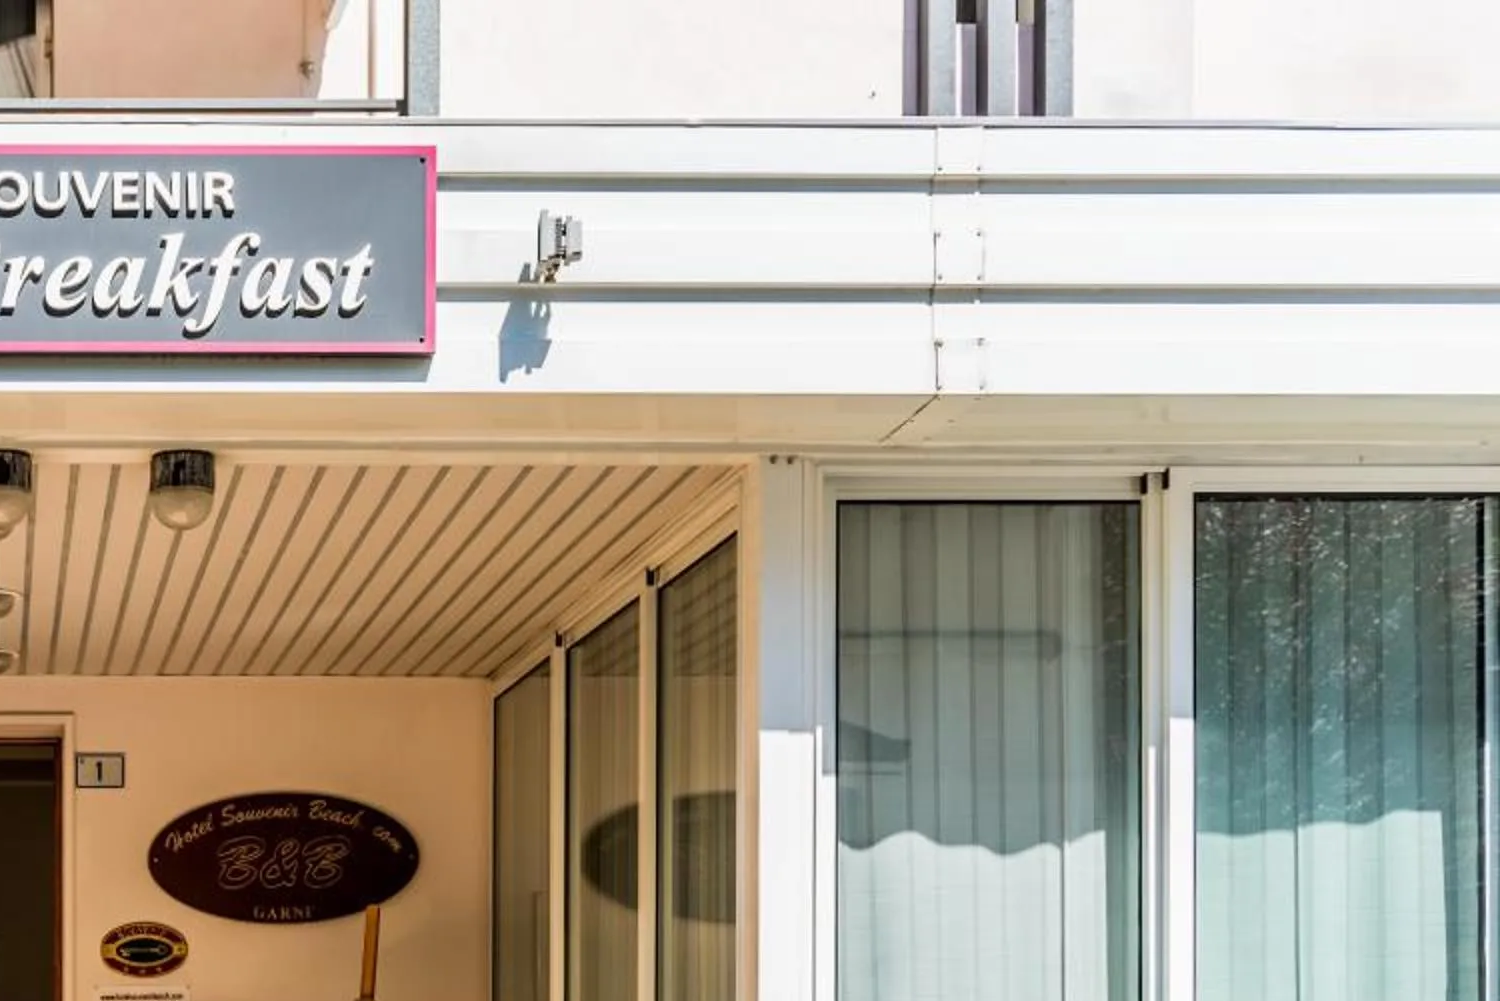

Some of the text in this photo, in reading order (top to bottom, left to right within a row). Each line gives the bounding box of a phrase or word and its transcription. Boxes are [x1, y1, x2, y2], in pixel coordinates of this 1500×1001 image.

[164, 812, 215, 853] Hotel
[220, 803, 299, 828] Souvenir
[308, 799, 366, 830] Beach
[217, 834, 352, 890] B&B
